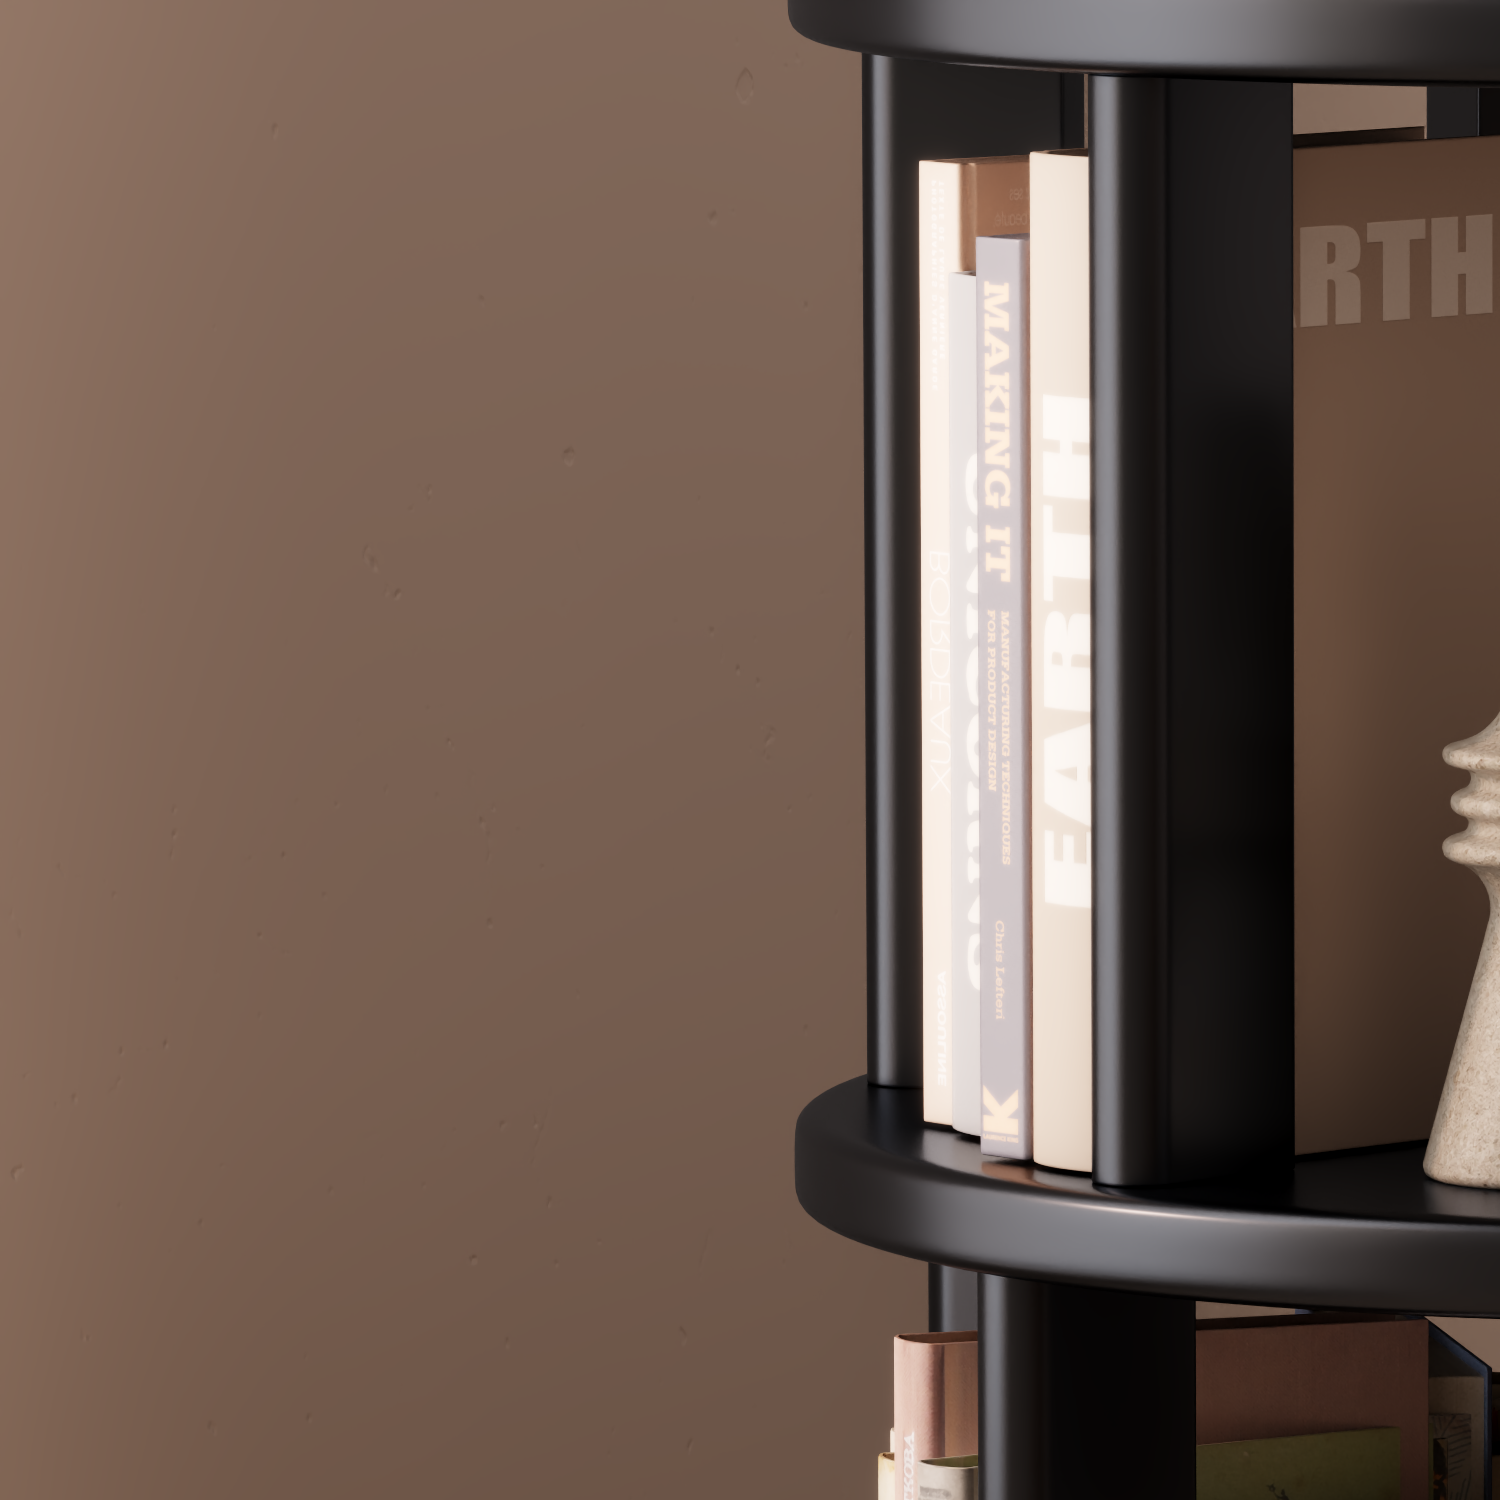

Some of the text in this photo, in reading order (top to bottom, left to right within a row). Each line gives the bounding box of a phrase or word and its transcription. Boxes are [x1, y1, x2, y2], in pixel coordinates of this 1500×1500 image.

[1293, 214, 1493, 328] RTH
[983, 280, 1011, 583] MAKING IT
[986, 609, 997, 793] FOR PRODUCT DESIGN
[1000, 610, 1011, 866] MANUFACTURING TECHNIQUES
[994, 919, 1006, 1020] Chris Lefteri
[982, 1084, 1019, 1136] K
